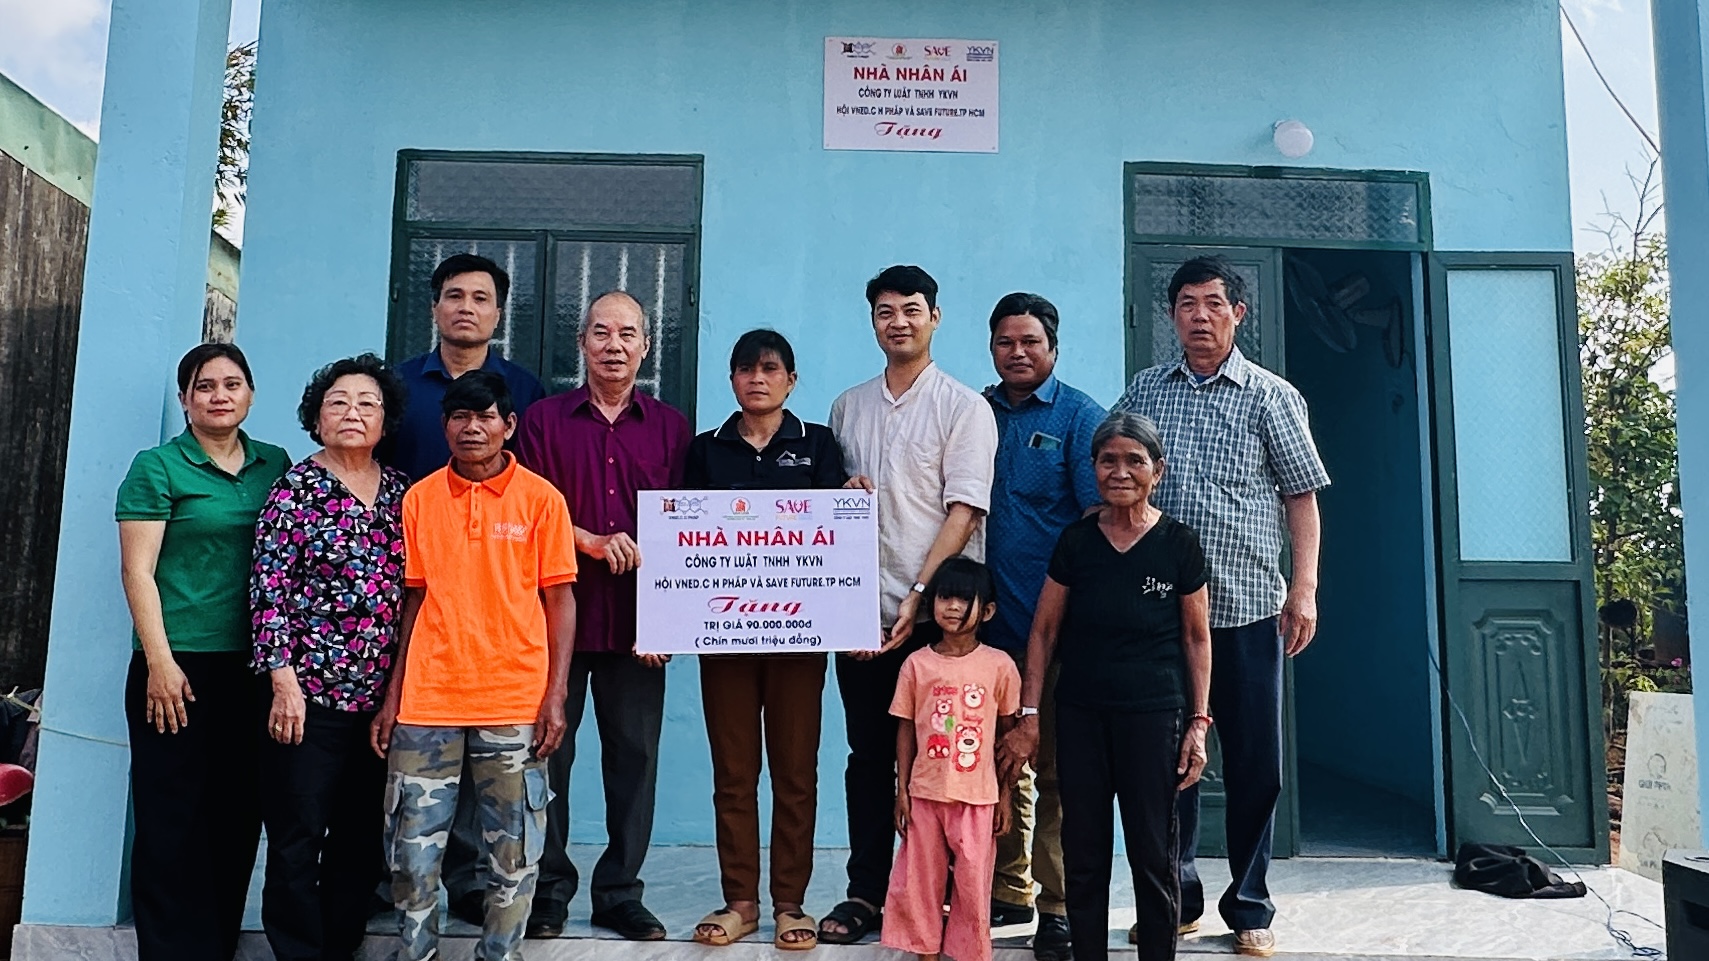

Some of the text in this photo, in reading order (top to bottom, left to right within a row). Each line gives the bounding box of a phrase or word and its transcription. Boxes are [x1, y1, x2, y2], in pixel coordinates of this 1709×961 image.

[854, 63, 967, 82] NHÀ NHÂN ÁI
[858, 85, 958, 101] CÔNG TY LUẬT TNHH YKVN
[885, 104, 903, 116] PHÁP
[904, 105, 914, 116] VÀ
[916, 107, 933, 117] SAVE
[874, 121, 942, 140] Tặng
[776, 499, 812, 513] SAVE
[833, 498, 870, 508] YKVN
[678, 525, 835, 547] NHÀ NHÂN ÁI
[685, 553, 823, 571] CÔNG TY LUẬT TNHH YKVN
[654, 575, 861, 593] HỘI VNED.C H PHÁP VÀ SAVE FUTURE.TP HCM
[707, 596, 803, 617] Tặng
[704, 619, 812, 633] TRỊ GIÁ 90.000.000đ
[703, 635, 728, 646] Chín
[731, 636, 758, 645] mươi
[761, 635, 785, 647] triệu
